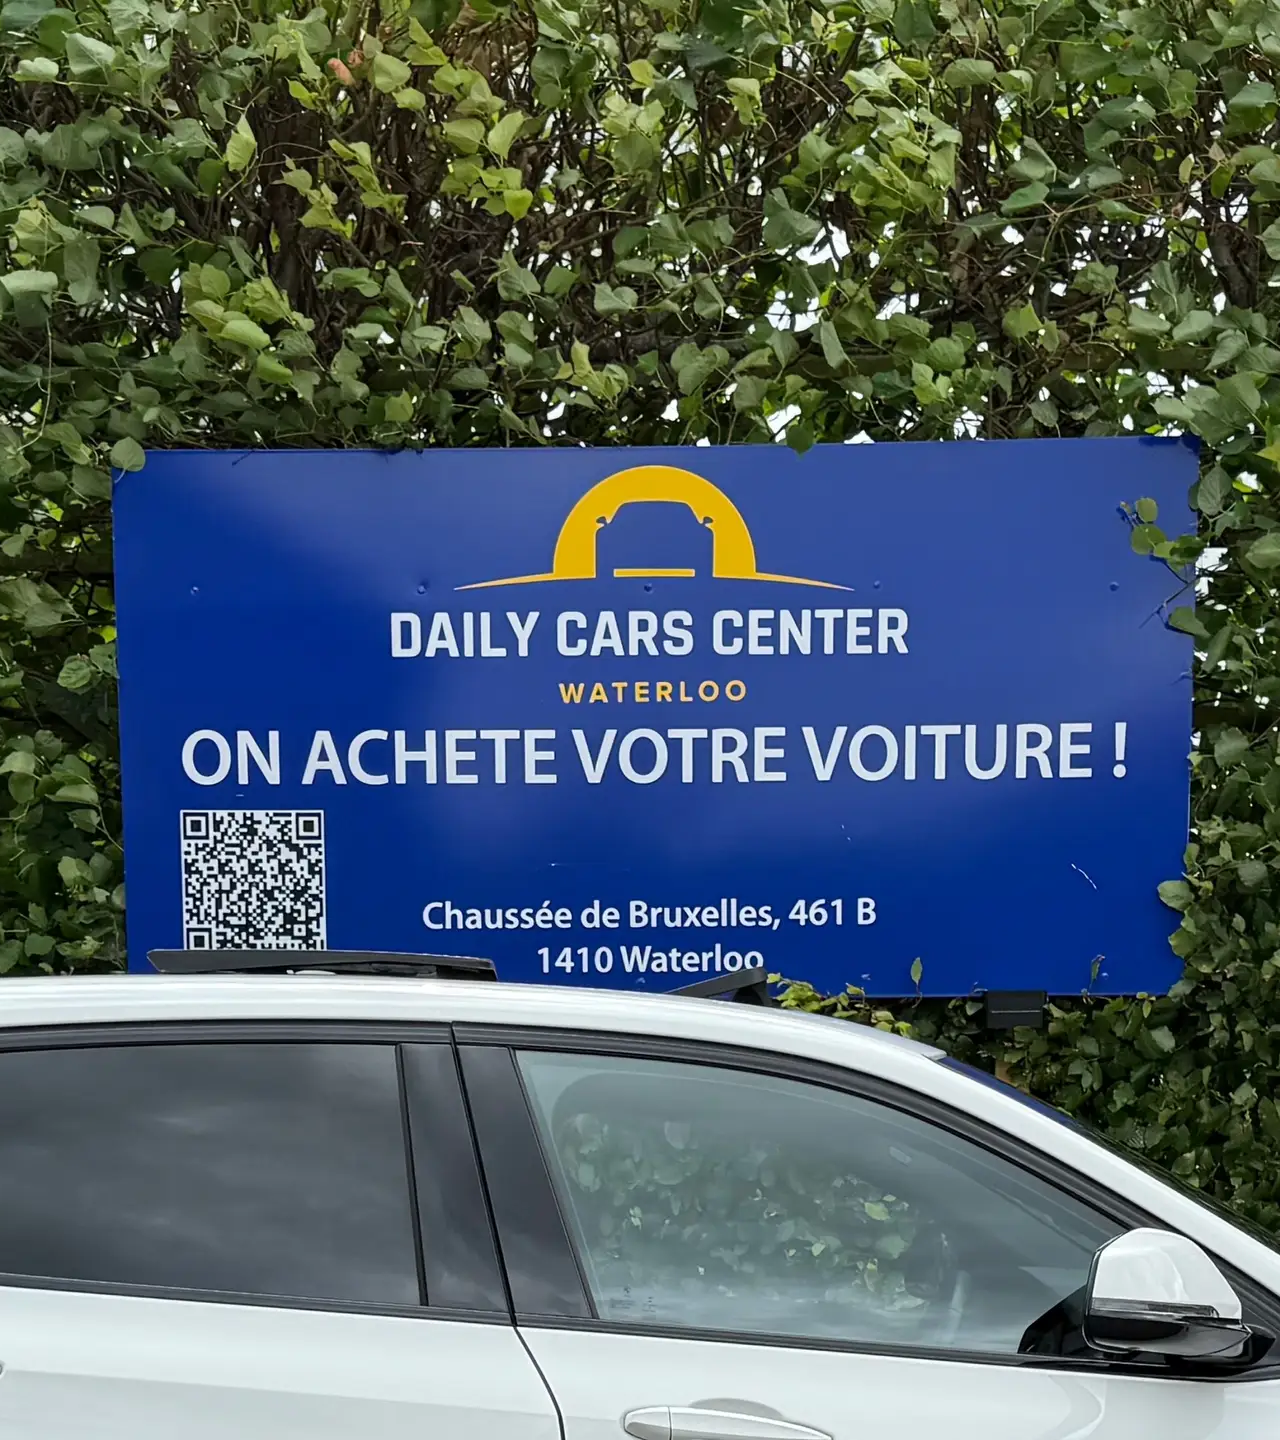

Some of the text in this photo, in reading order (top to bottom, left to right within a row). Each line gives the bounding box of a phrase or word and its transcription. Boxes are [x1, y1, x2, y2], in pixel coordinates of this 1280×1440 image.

[390, 607, 910, 659] DAILY CARS CENTER
[557, 679, 748, 706] WATERLOO
[180, 720, 1128, 787] ON ACHETE VOTRE VOITURE !
[421, 896, 878, 932] Chaussée de Bruxelles, 461 B
[536, 942, 764, 975] 1410 Waterloo
